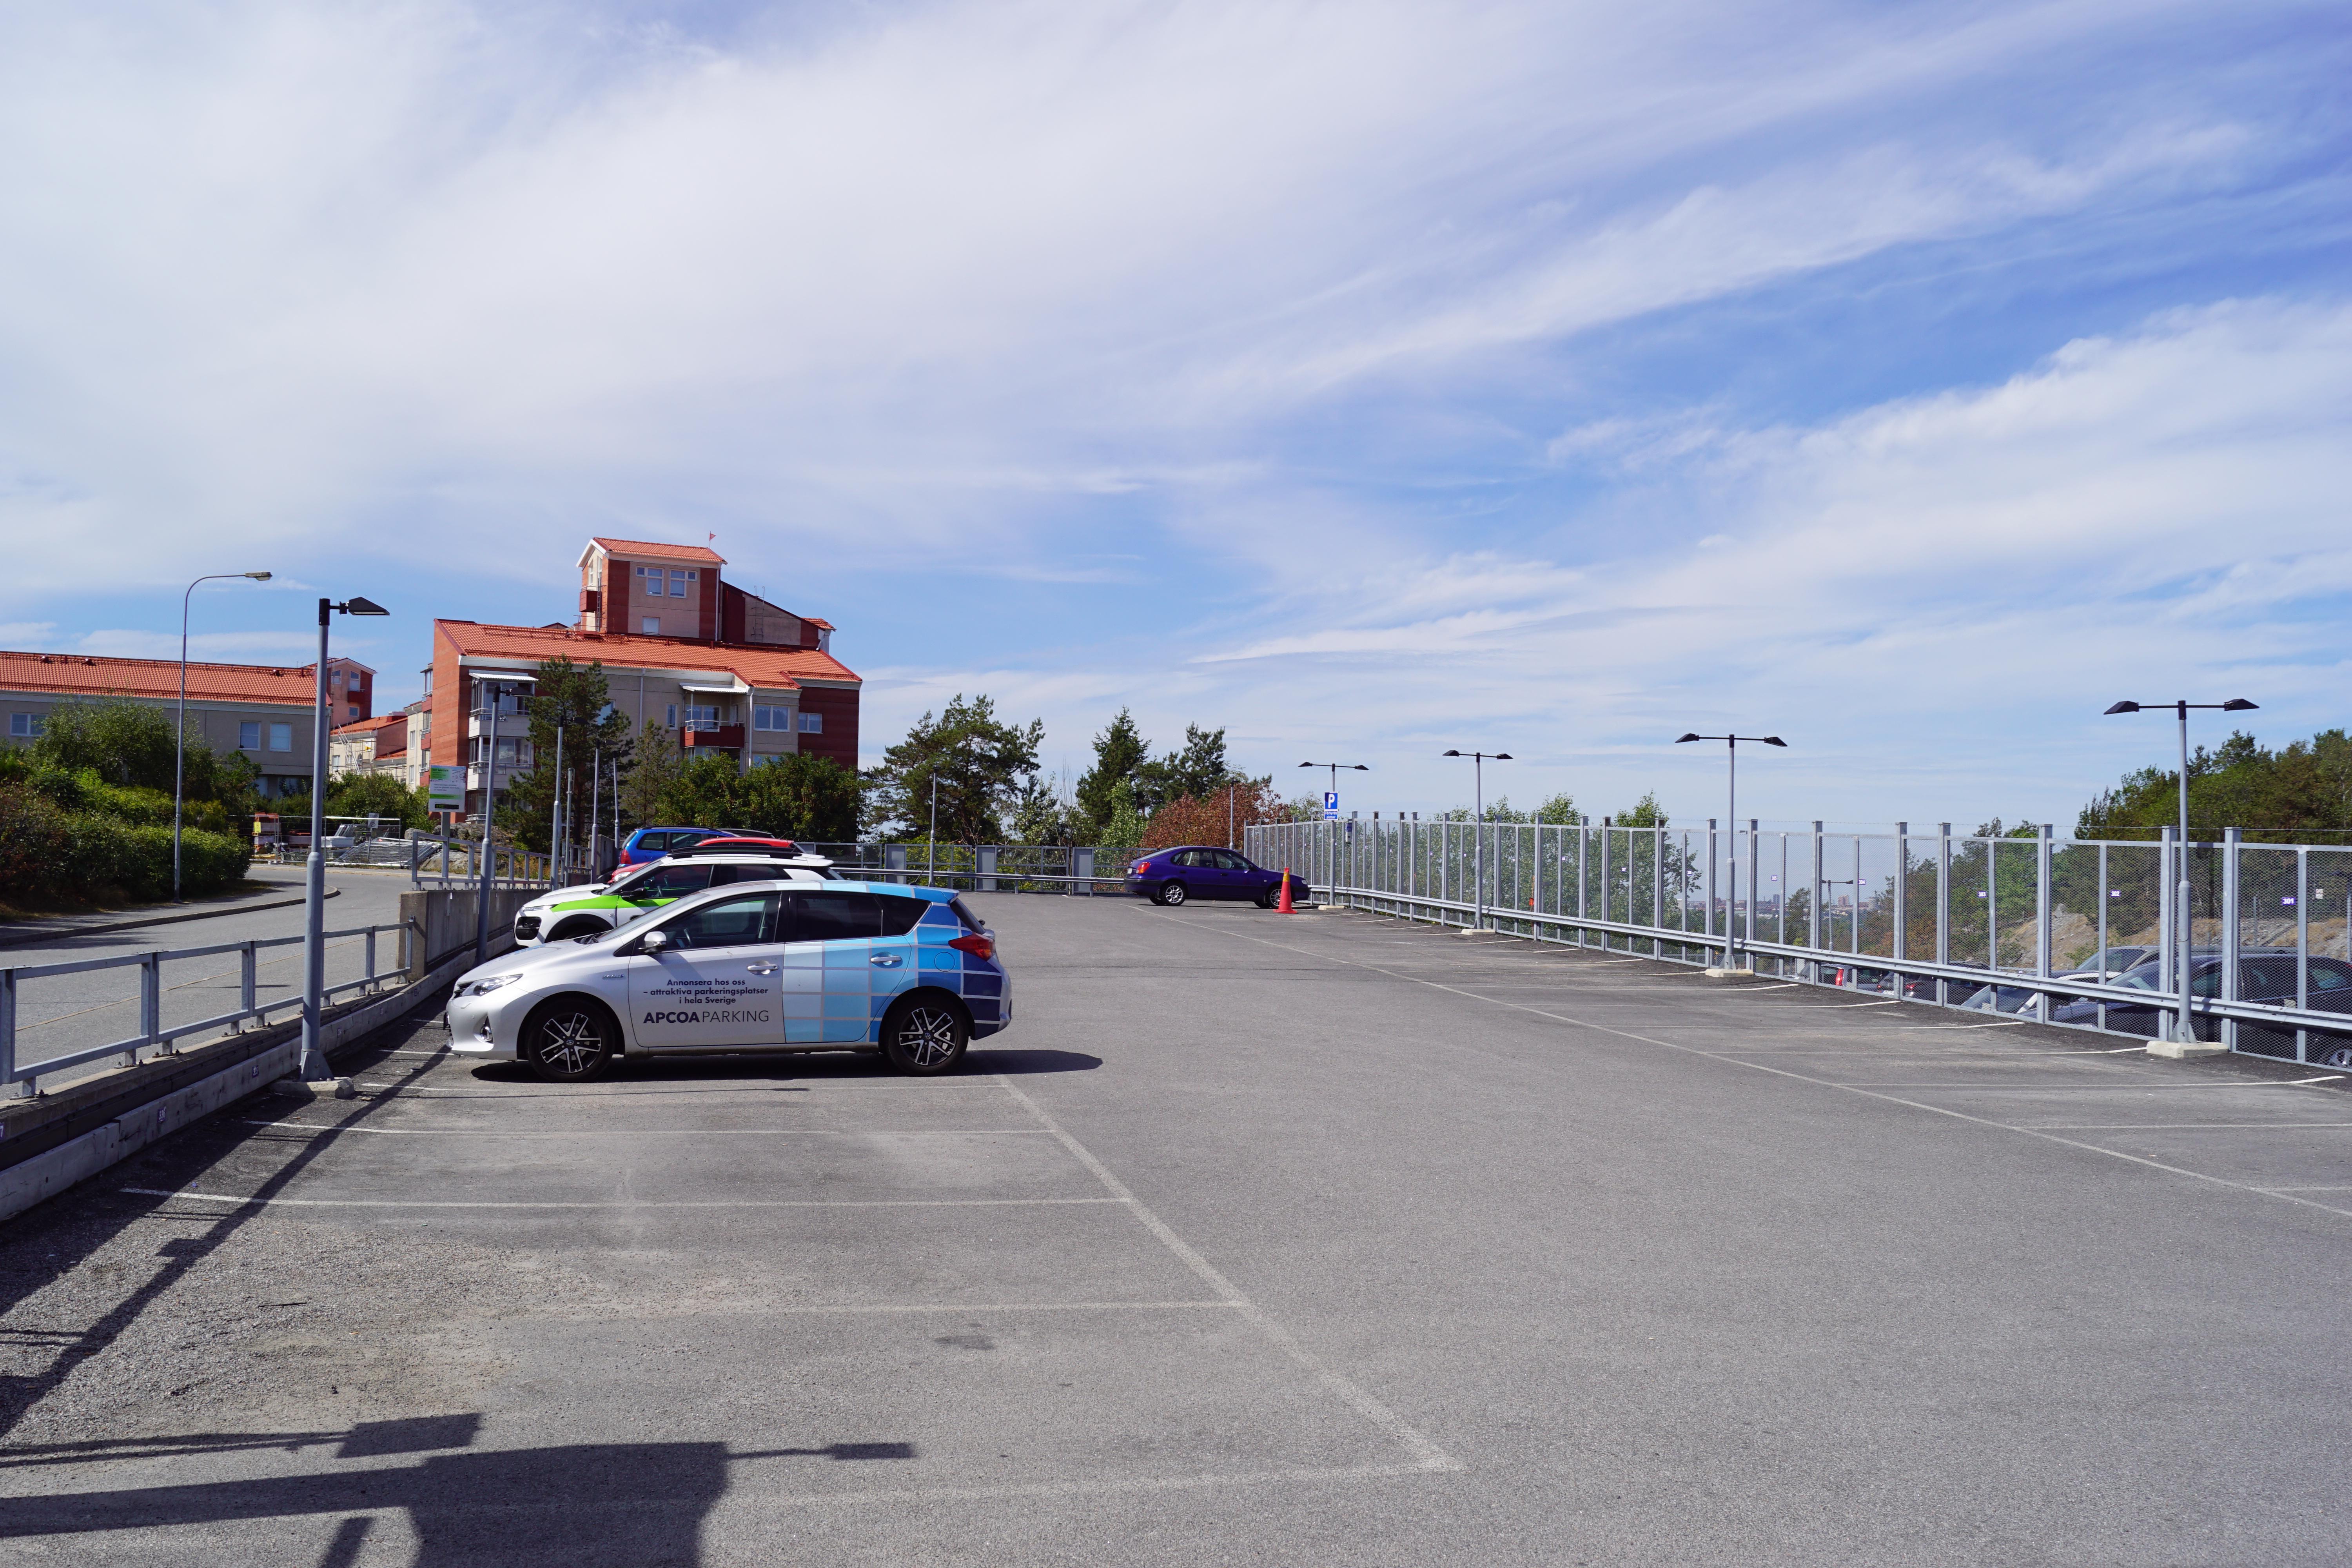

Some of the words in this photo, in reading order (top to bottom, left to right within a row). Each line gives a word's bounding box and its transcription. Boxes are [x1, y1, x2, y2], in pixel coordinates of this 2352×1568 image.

[1328, 794, 1335, 808] P
[695, 987, 768, 996] parkeringsplatser
[705, 996, 736, 1005] Sverige
[643, 1012, 700, 1024] APCOA
[702, 1010, 769, 1023] PARKING
